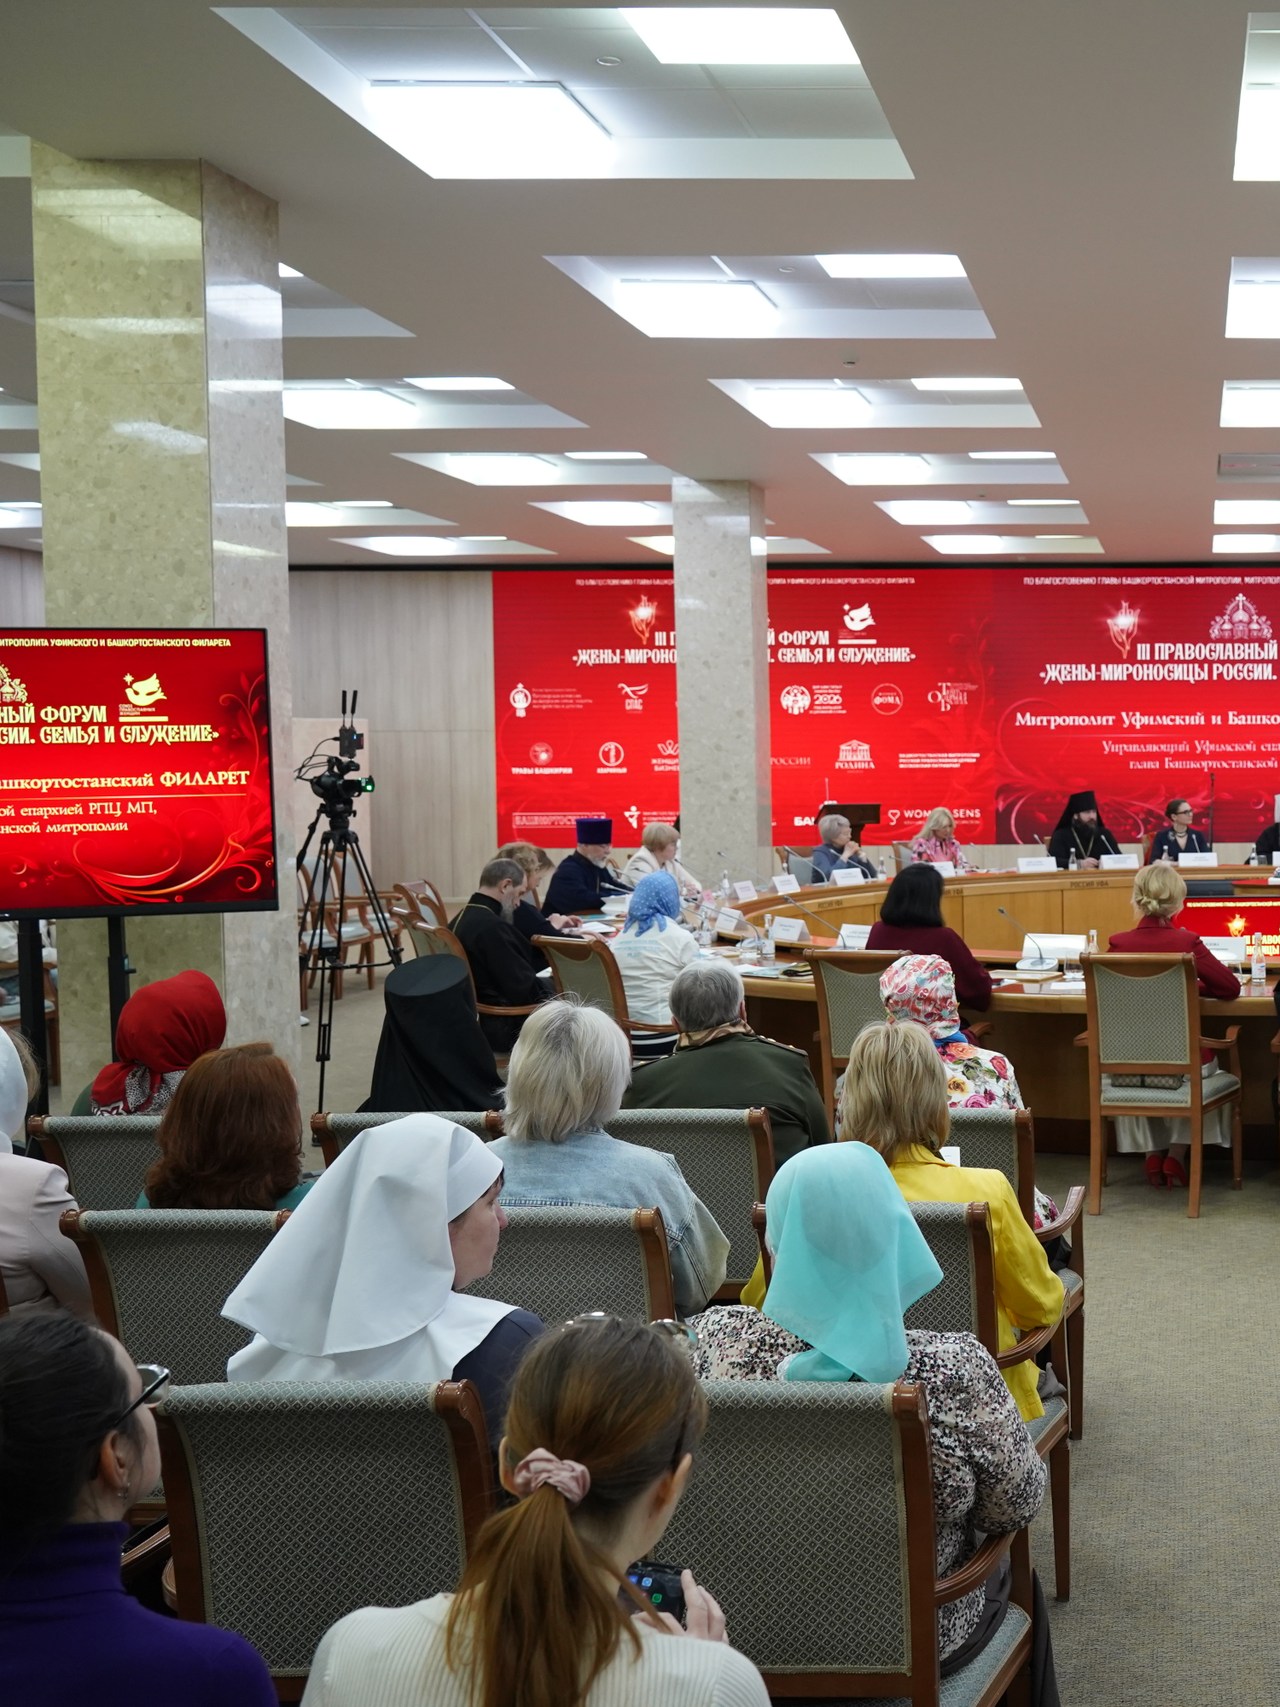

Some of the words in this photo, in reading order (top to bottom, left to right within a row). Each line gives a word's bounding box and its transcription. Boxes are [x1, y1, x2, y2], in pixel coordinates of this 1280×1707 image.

[1024, 577, 1034, 585] ПО
[1035, 577, 1096, 585] БЛАГОСЛОВЕНИЮ
[1098, 577, 1121, 585] ГЛАВЫ
[1122, 576, 1194, 585] БАШКОРТОСТАНСКОЙ
[0, 638, 49, 648] ИТРОПОЛИТА
[50, 638, 98, 648] УФИМСКОГО
[100, 638, 105, 647] И
[107, 638, 191, 647] БАШКОРТОСТАНСКОГО
[192, 638, 231, 647] ФИЛАРЕТА
[655, 631, 667, 646] III
[778, 630, 829, 645] ФОРУМ
[572, 649, 677, 666] «ЖЕНЫ-МИРОНО
[778, 648, 823, 664] СЕМЬЯ
[827, 648, 835, 662] И
[838, 647, 916, 665] СЛУЖЕНИЕ»
[1137, 643, 1150, 660] III
[1154, 640, 1278, 660] ПРАВОСЛАВНЫЙ
[1039, 664, 1208, 684] «ЖЕНЫ-МИРОНОСИЦЫ
[1213, 663, 1277, 680] РОССИИ.
[814, 694, 842, 705] 2026
[873, 695, 901, 705] ФОМА
[40, 705, 107, 724] ФОРУМ
[1015, 712, 1115, 730] Митрополит
[1121, 711, 1205, 729] Уфимский
[1211, 715, 1222, 725] и
[0, 727, 35, 744] СИИ.
[40, 726, 99, 745] СЕМЬЯ
[104, 726, 115, 743] И
[120, 724, 219, 746] СЛУЖЕНИЕ»
[1102, 740, 1189, 755] Управляющий
[1194, 740, 1256, 754] Уфимской
[835, 761, 875, 770] РОДИНА
[1129, 759, 1160, 770] глава
[1164, 757, 1278, 772] Башкортостанской
[0, 774, 153, 793] шкортостанский
[160, 771, 250, 787] ФИЛАРЕТ
[21, 804, 83, 820] епархией
[89, 802, 121, 818] РПЦ
[127, 801, 157, 815] МП,
[904, 809, 930, 818] WOM
[953, 808, 981, 818] SENS
[46, 822, 128, 836] митрополии
